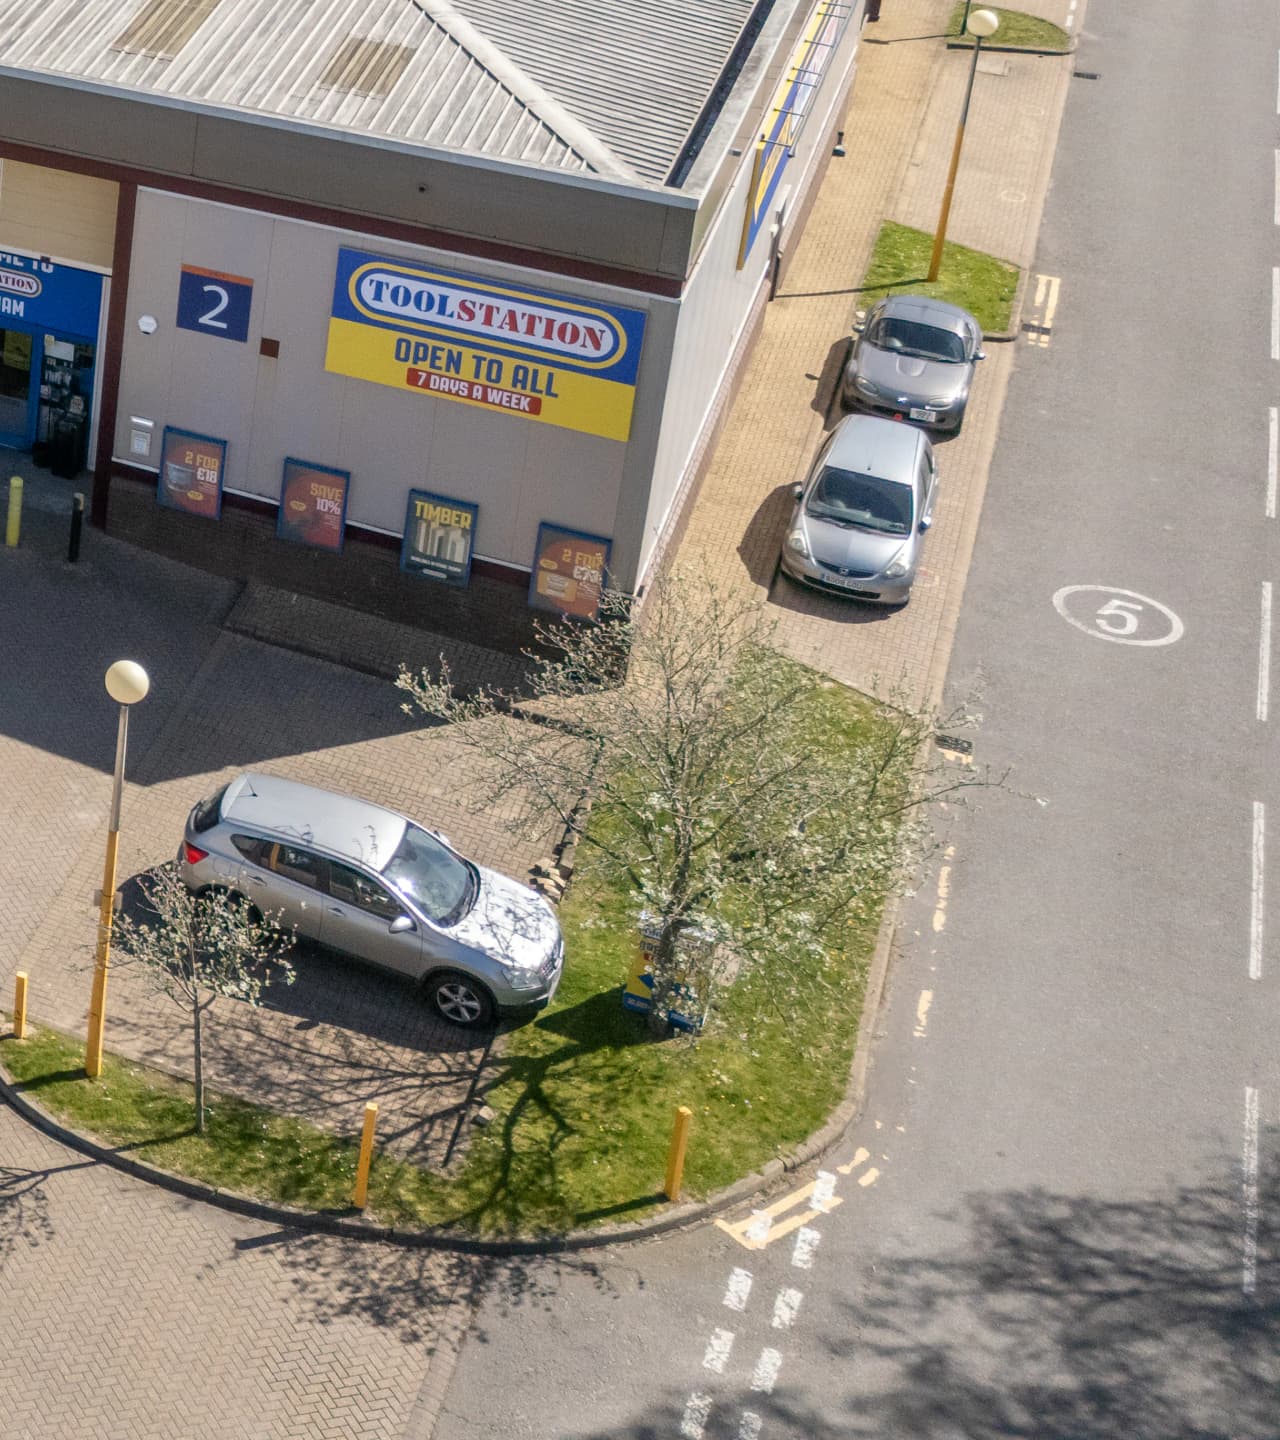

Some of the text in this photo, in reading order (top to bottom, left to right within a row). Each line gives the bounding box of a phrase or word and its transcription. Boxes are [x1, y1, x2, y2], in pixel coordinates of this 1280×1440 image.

[198, 284, 230, 329] 2
[368, 278, 606, 352] TOOLSTATION
[394, 337, 559, 398] OPEN TO ALL
[417, 371, 532, 412] 7 DAYS A WEEK
[185, 451, 219, 471] 2 FOR
[310, 482, 343, 503] SAVE
[316, 496, 341, 515] 10%
[415, 500, 472, 529] TIMBER
[562, 548, 572, 563] 2
[1095, 599, 1143, 635] 5
